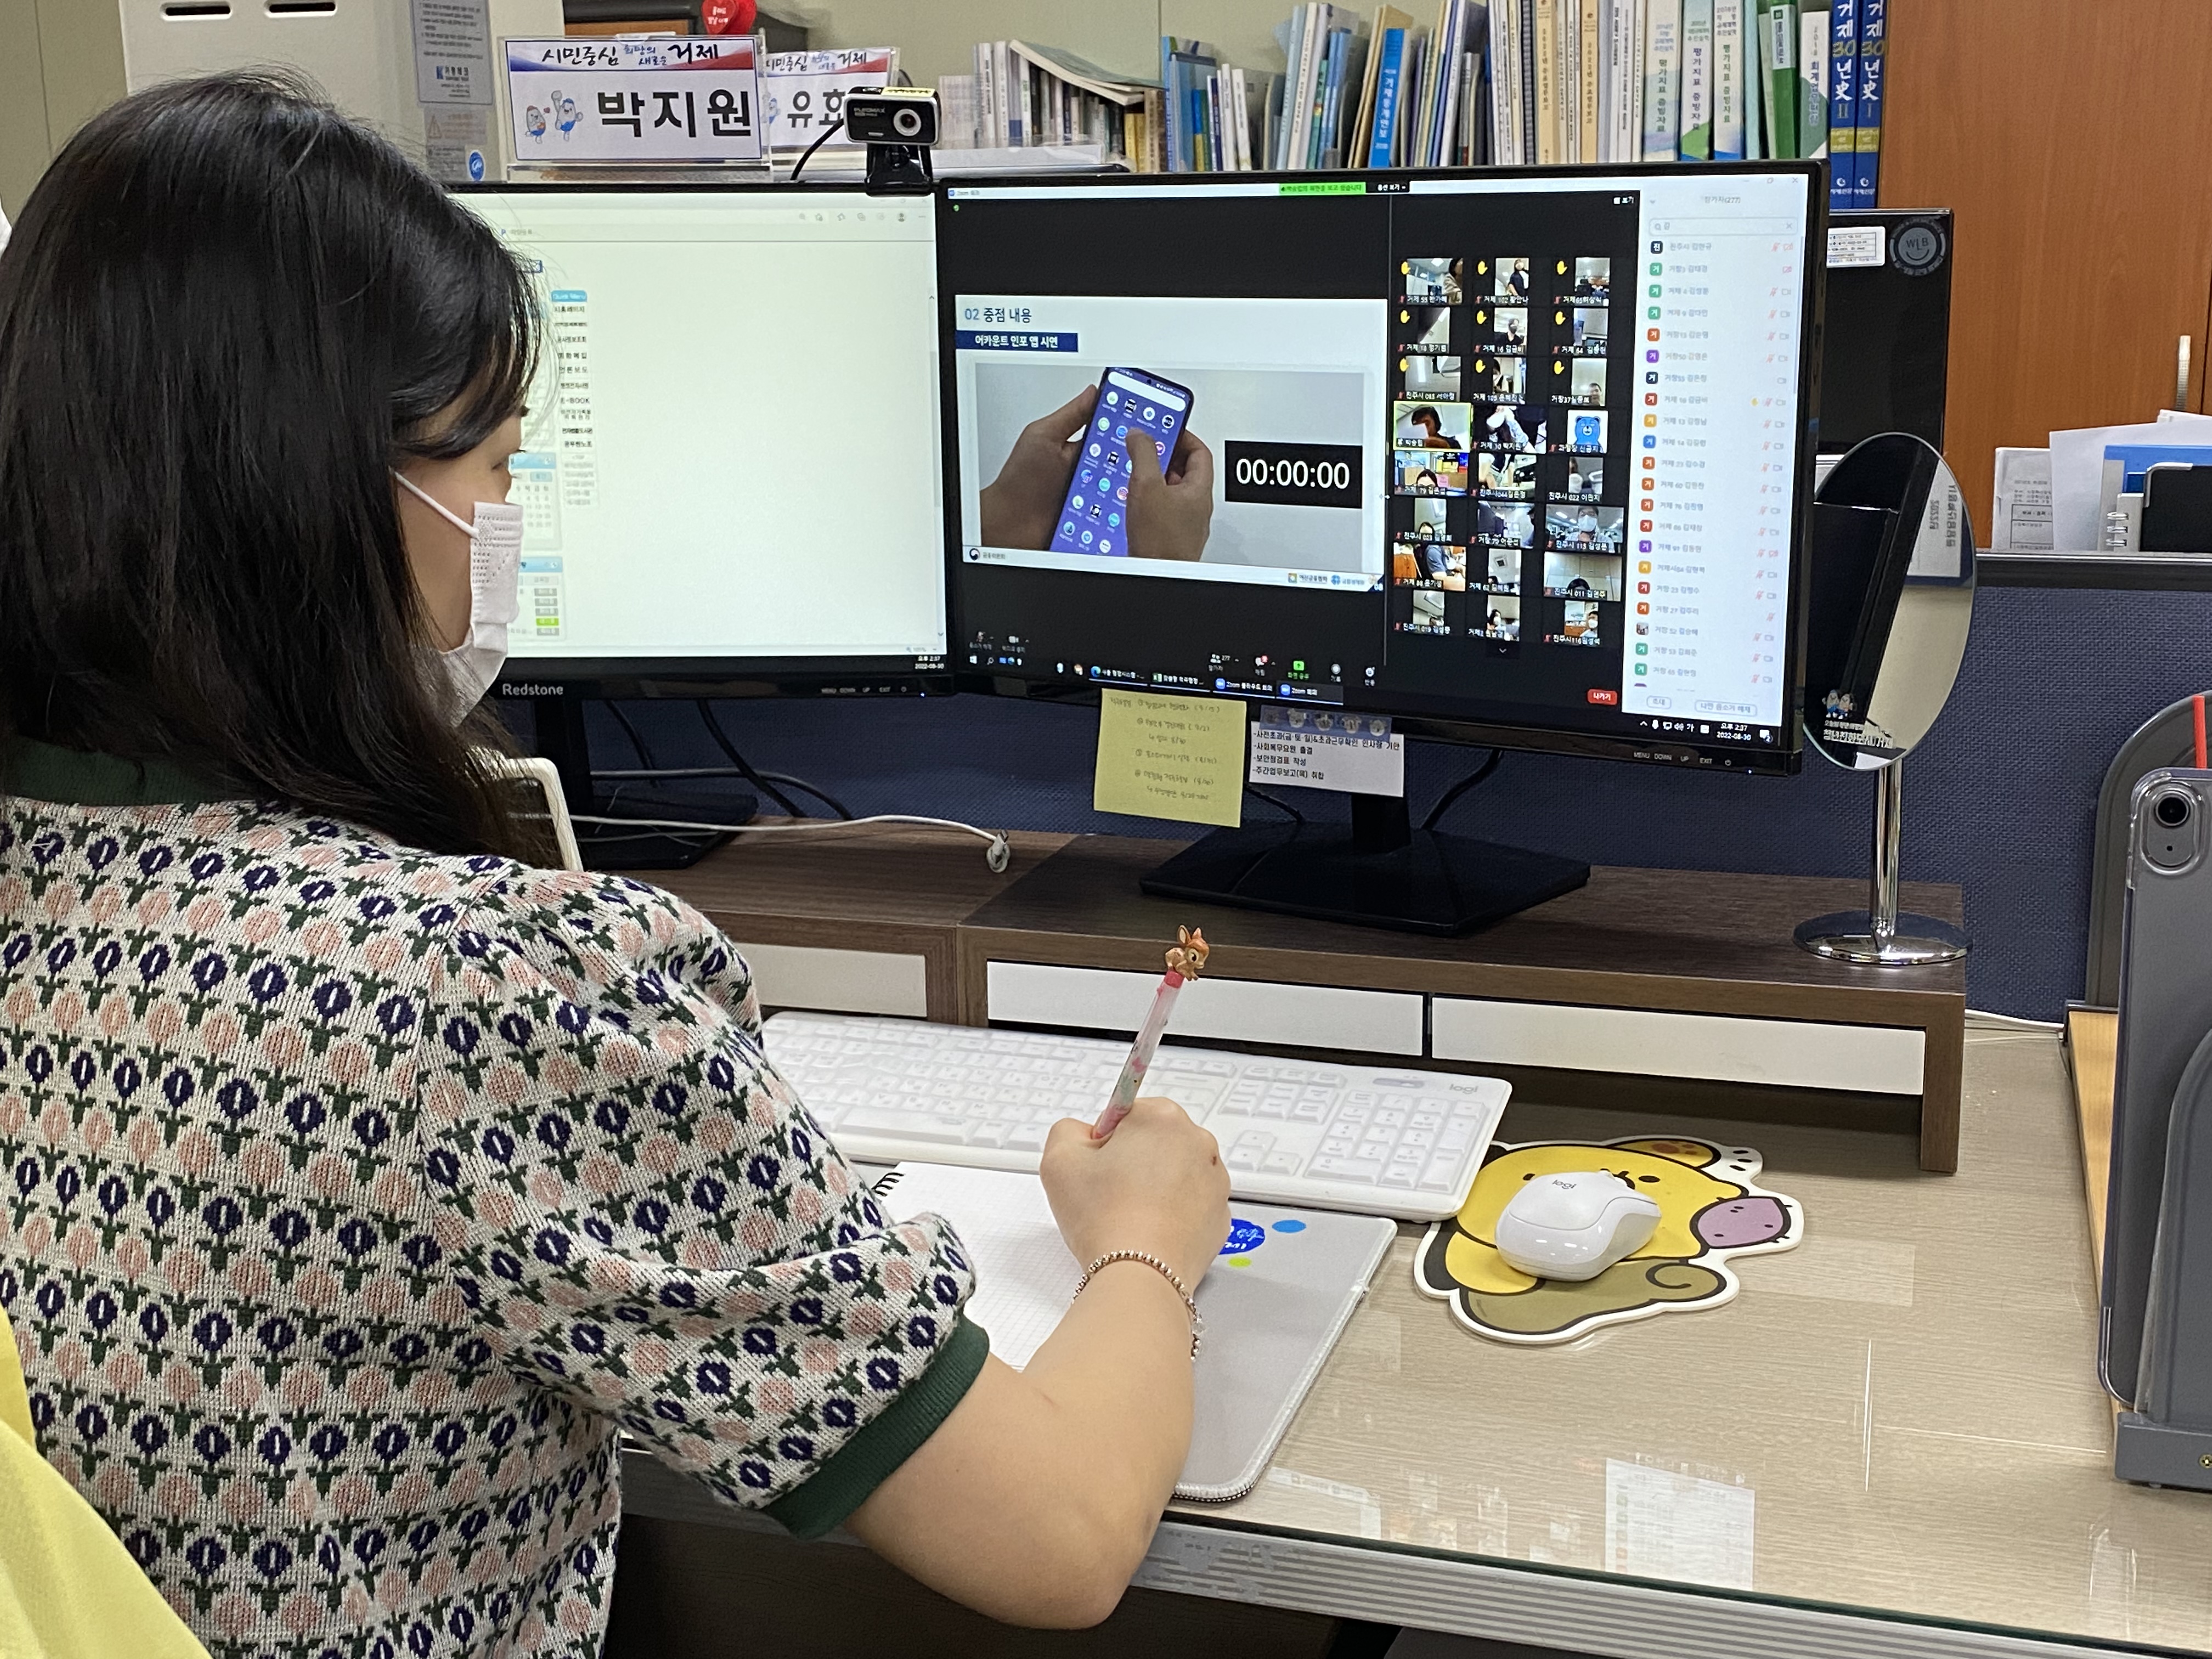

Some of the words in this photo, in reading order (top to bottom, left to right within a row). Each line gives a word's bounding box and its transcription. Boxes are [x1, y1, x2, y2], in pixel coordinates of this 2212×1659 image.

[541, 46, 619, 66] 시민중심
[668, 43, 719, 65] 거제
[838, 52, 867, 68] 거제
[639, 56, 668, 66] 새로운
[1692, 48, 1702, 86] 평가지표
[1658, 59, 1667, 93] 평가지표
[597, 89, 752, 138] 박지원
[787, 88, 846, 128] 유효
[1691, 93, 1700, 130] 증빙자료
[1906, 237, 1929, 251] WLB
[964, 308, 979, 320] 02
[984, 307, 1005, 323] 중점
[1009, 307, 1032, 323] 내용
[975, 335, 1009, 347] 어카운트
[1011, 336, 1028, 347] 인포
[1029, 336, 1039, 348] 앱
[1041, 336, 1058, 348] 시연
[1406, 391, 1424, 399] 진주시
[1236, 458, 1350, 489] 00:00:00
[1549, 492, 1567, 500] 진주시
[1404, 532, 1421, 540] 진주시
[1555, 588, 1572, 596] 진주시
[1403, 623, 1420, 631] 진주시
[502, 683, 563, 696] Redstone
[1593, 692, 1611, 701] 나가기
[1687, 724, 1694, 732] 가
[1300, 746, 1312, 755] 출결
[1386, 742, 1400, 751] 기안
[1293, 757, 1306, 766] 작성
[1311, 771, 1324, 780] 취합
[1449, 1082, 1478, 1095] logi
[1551, 1178, 1577, 1190] logi
